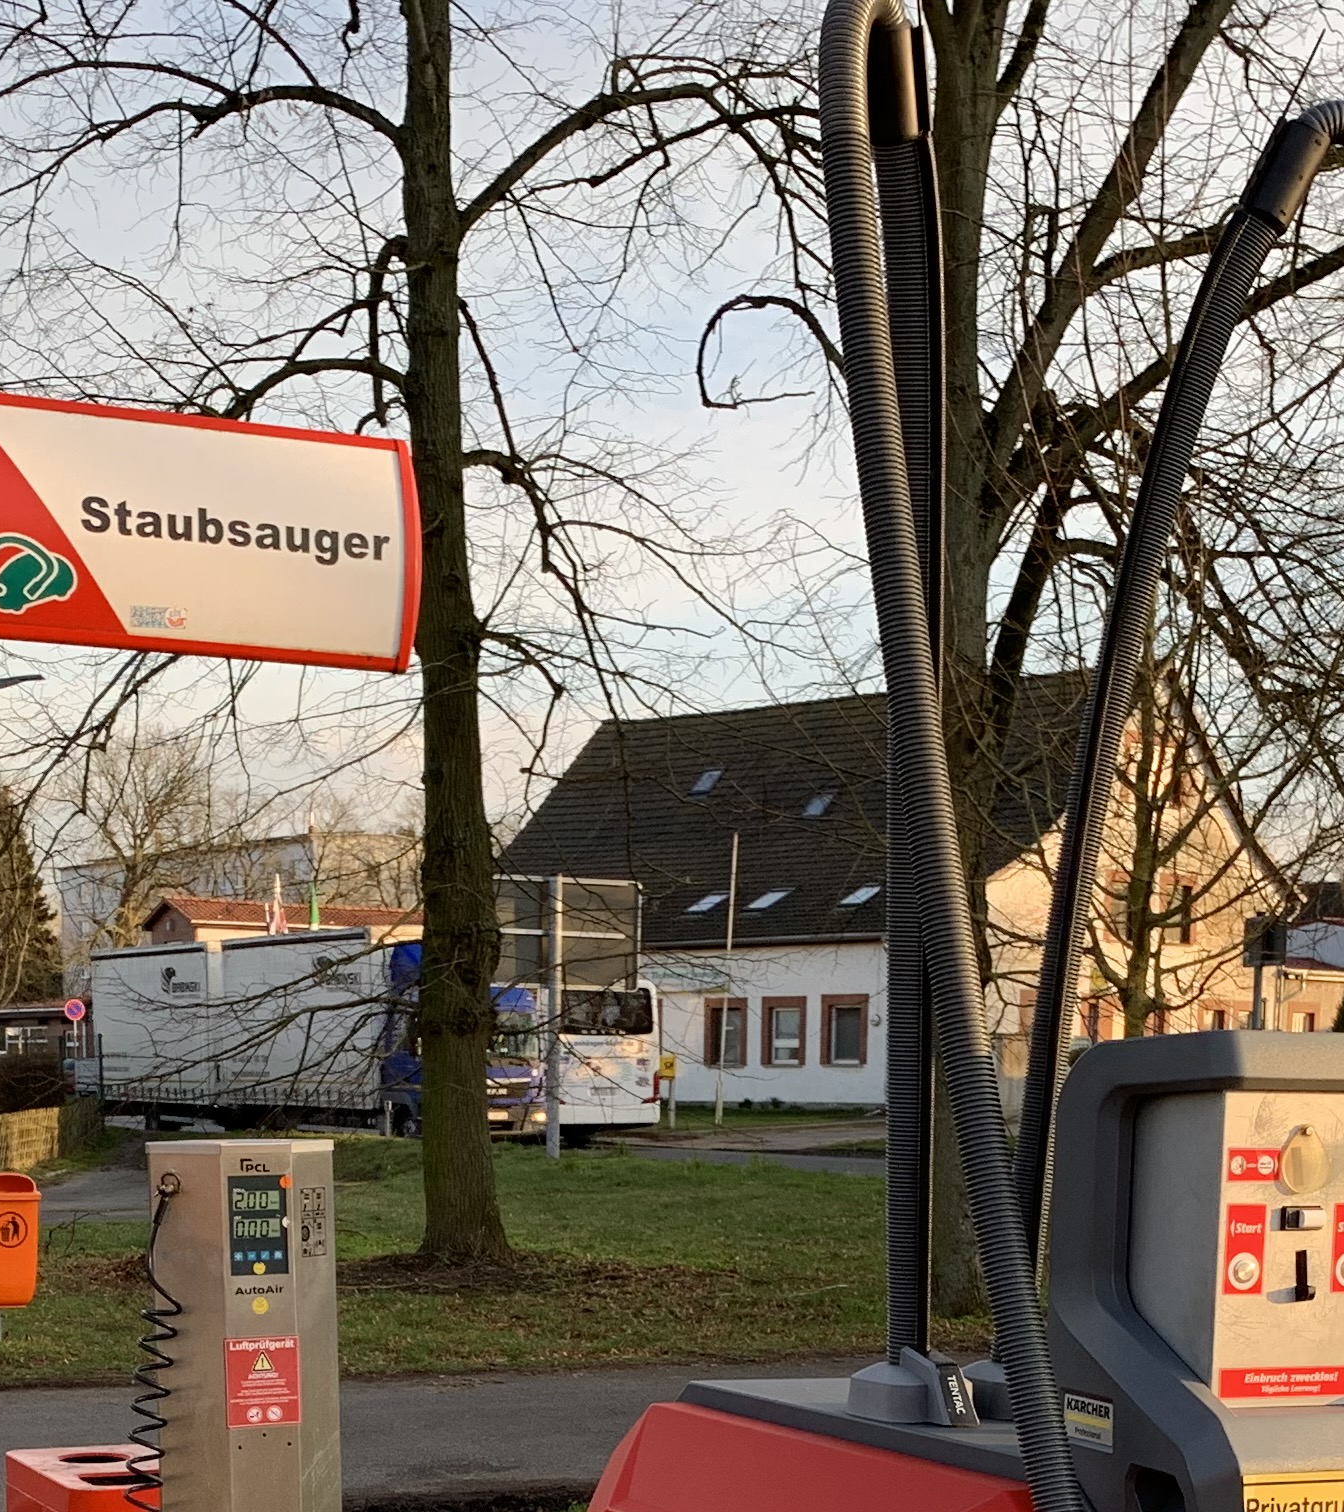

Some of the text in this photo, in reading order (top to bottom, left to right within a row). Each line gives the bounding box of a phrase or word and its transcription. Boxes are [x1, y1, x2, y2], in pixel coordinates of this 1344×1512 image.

[81, 496, 391, 566] Staubsauger
[242, 1161, 270, 1173] PCL
[234, 1192, 269, 1210] 2.00
[235, 1220, 270, 1238] 0.00
[1235, 1222, 1263, 1234] Start
[235, 1285, 284, 1296] AutoAir
[229, 1339, 295, 1352] Luftprüfgerät
[1244, 1371, 1339, 1384] Einbruch zwecklos!
[1066, 1397, 1110, 1419] KÄRCHER
